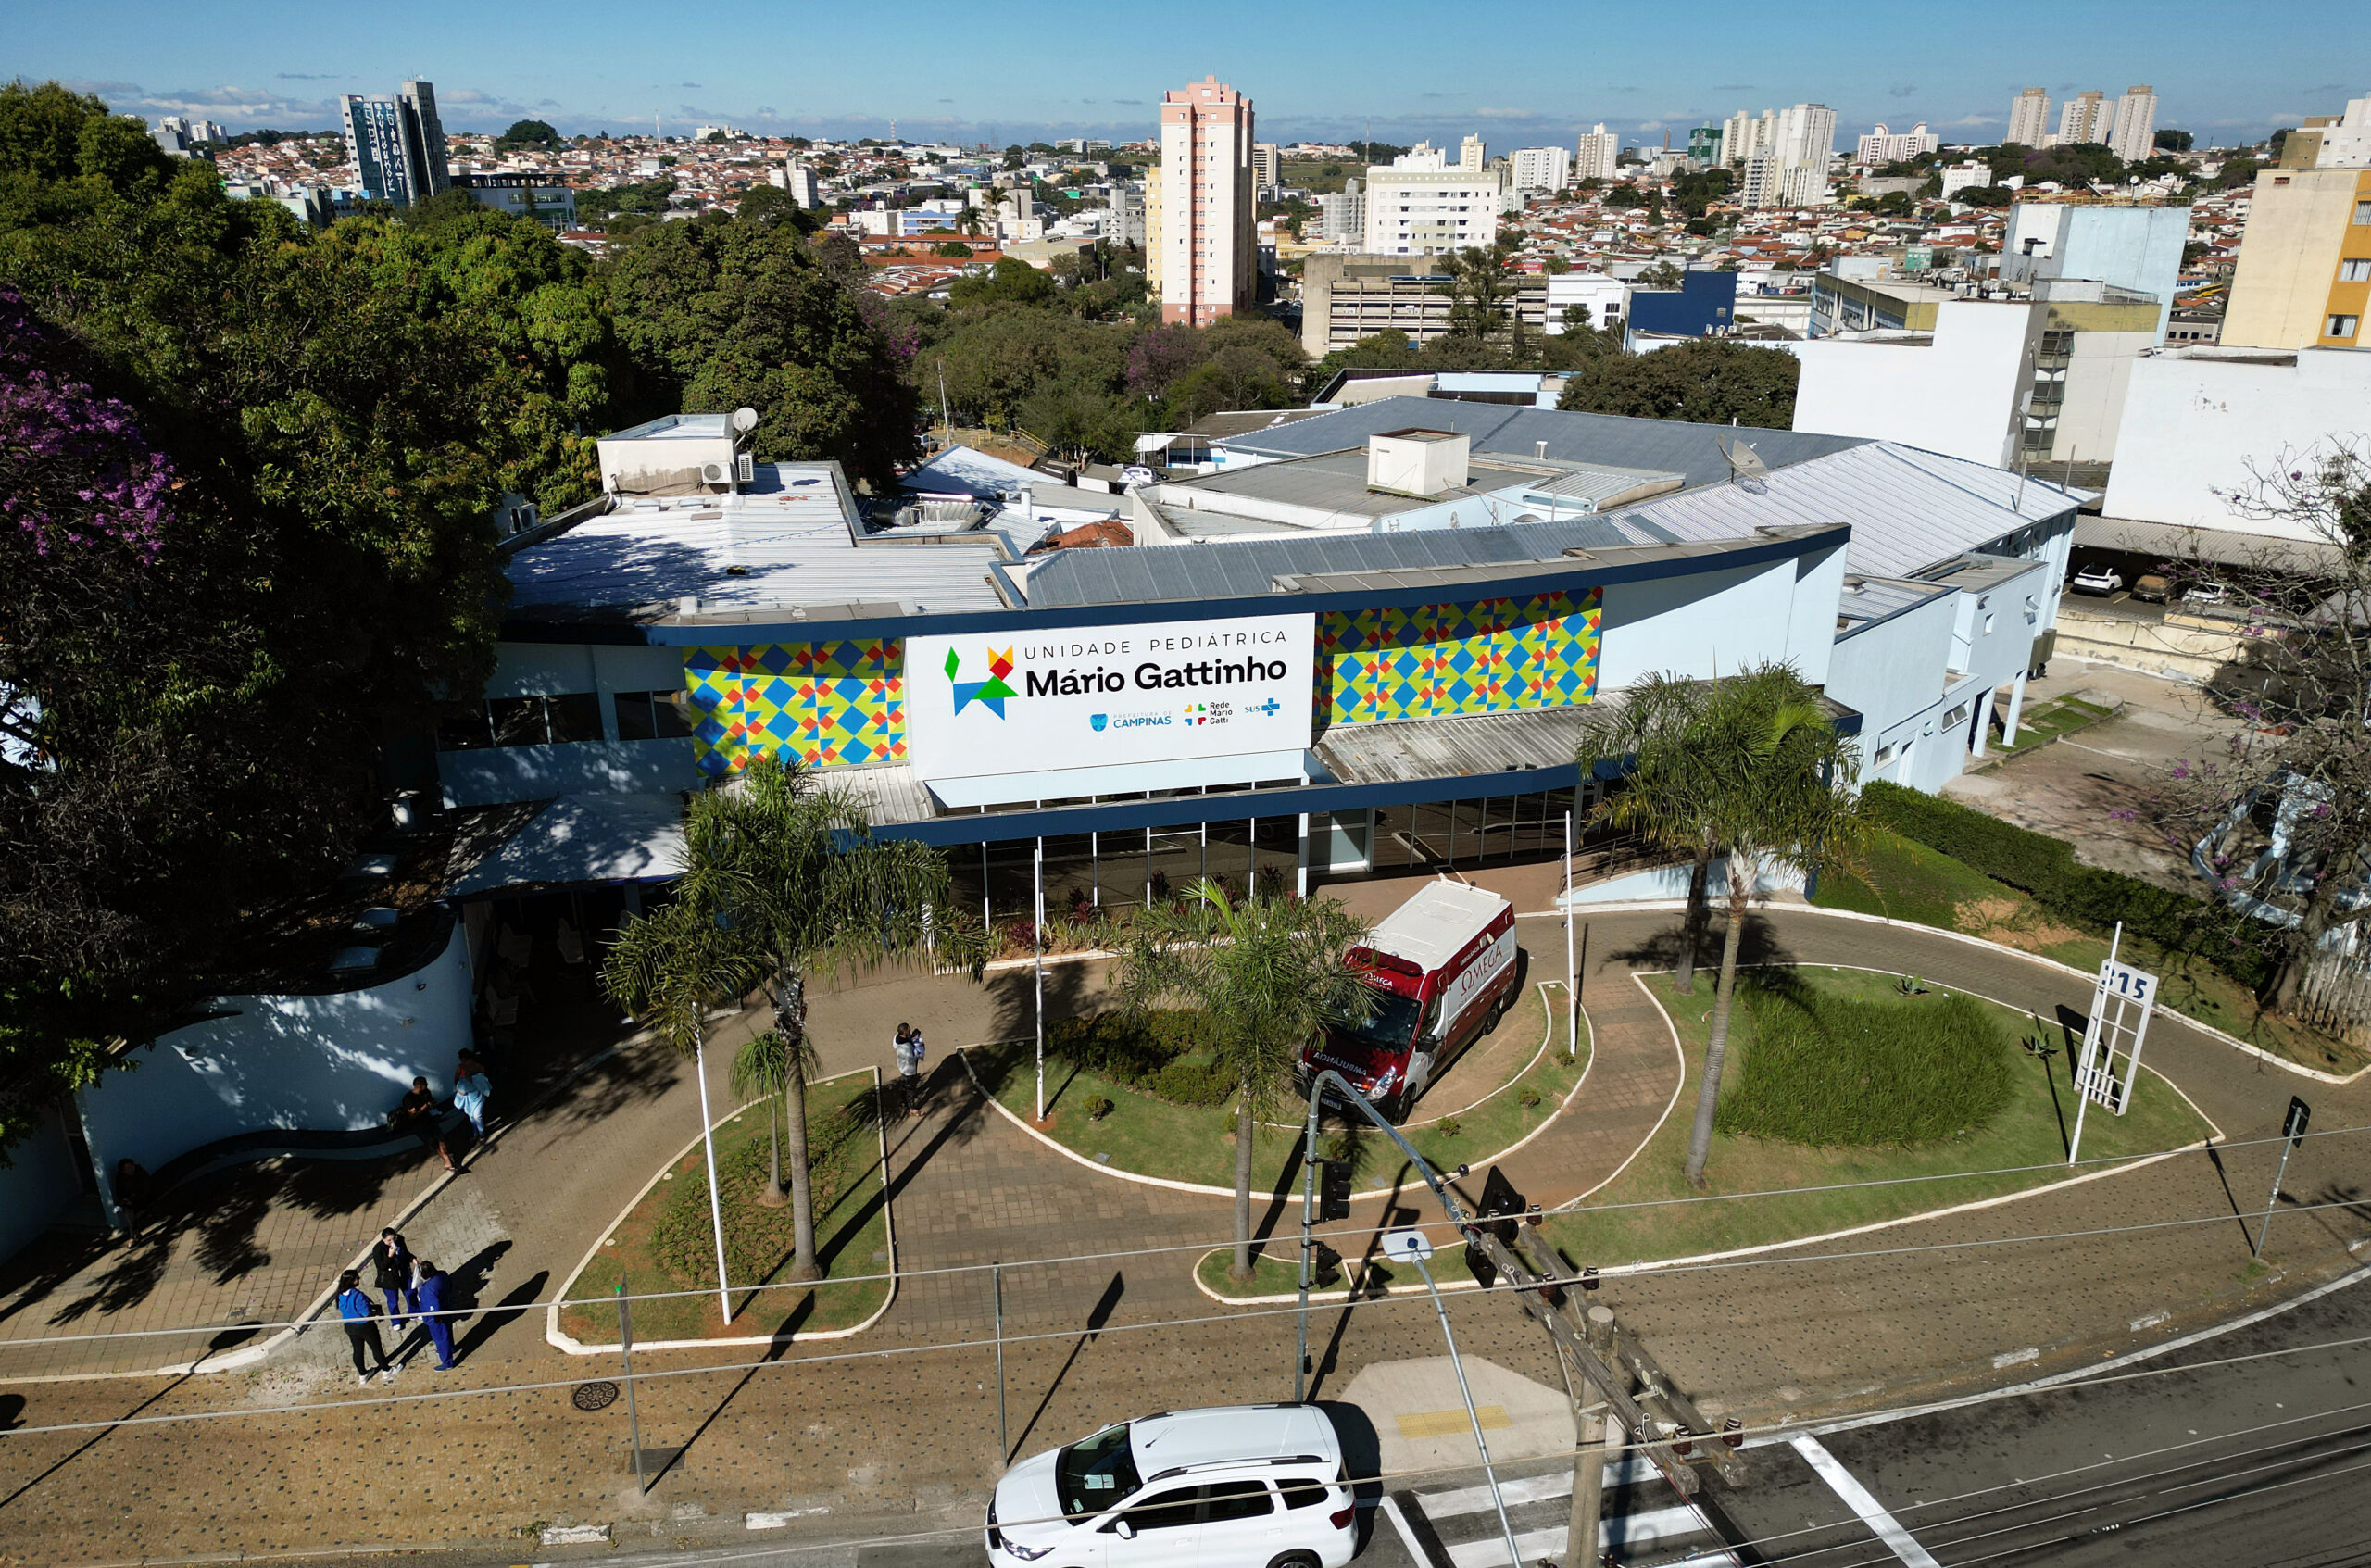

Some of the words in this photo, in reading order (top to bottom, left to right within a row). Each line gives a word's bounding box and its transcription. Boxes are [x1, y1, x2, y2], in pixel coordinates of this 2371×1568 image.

[1024, 641, 1131, 659] UNIDADE
[1149, 631, 1286, 651] PEDIÁTRICA
[1025, 666, 1125, 697] Mário
[1135, 656, 1287, 690] Gattinho
[1210, 701, 1230, 709] Rede
[1244, 705, 1261, 713] SUS
[1113, 716, 1172, 729] CAMPINAS
